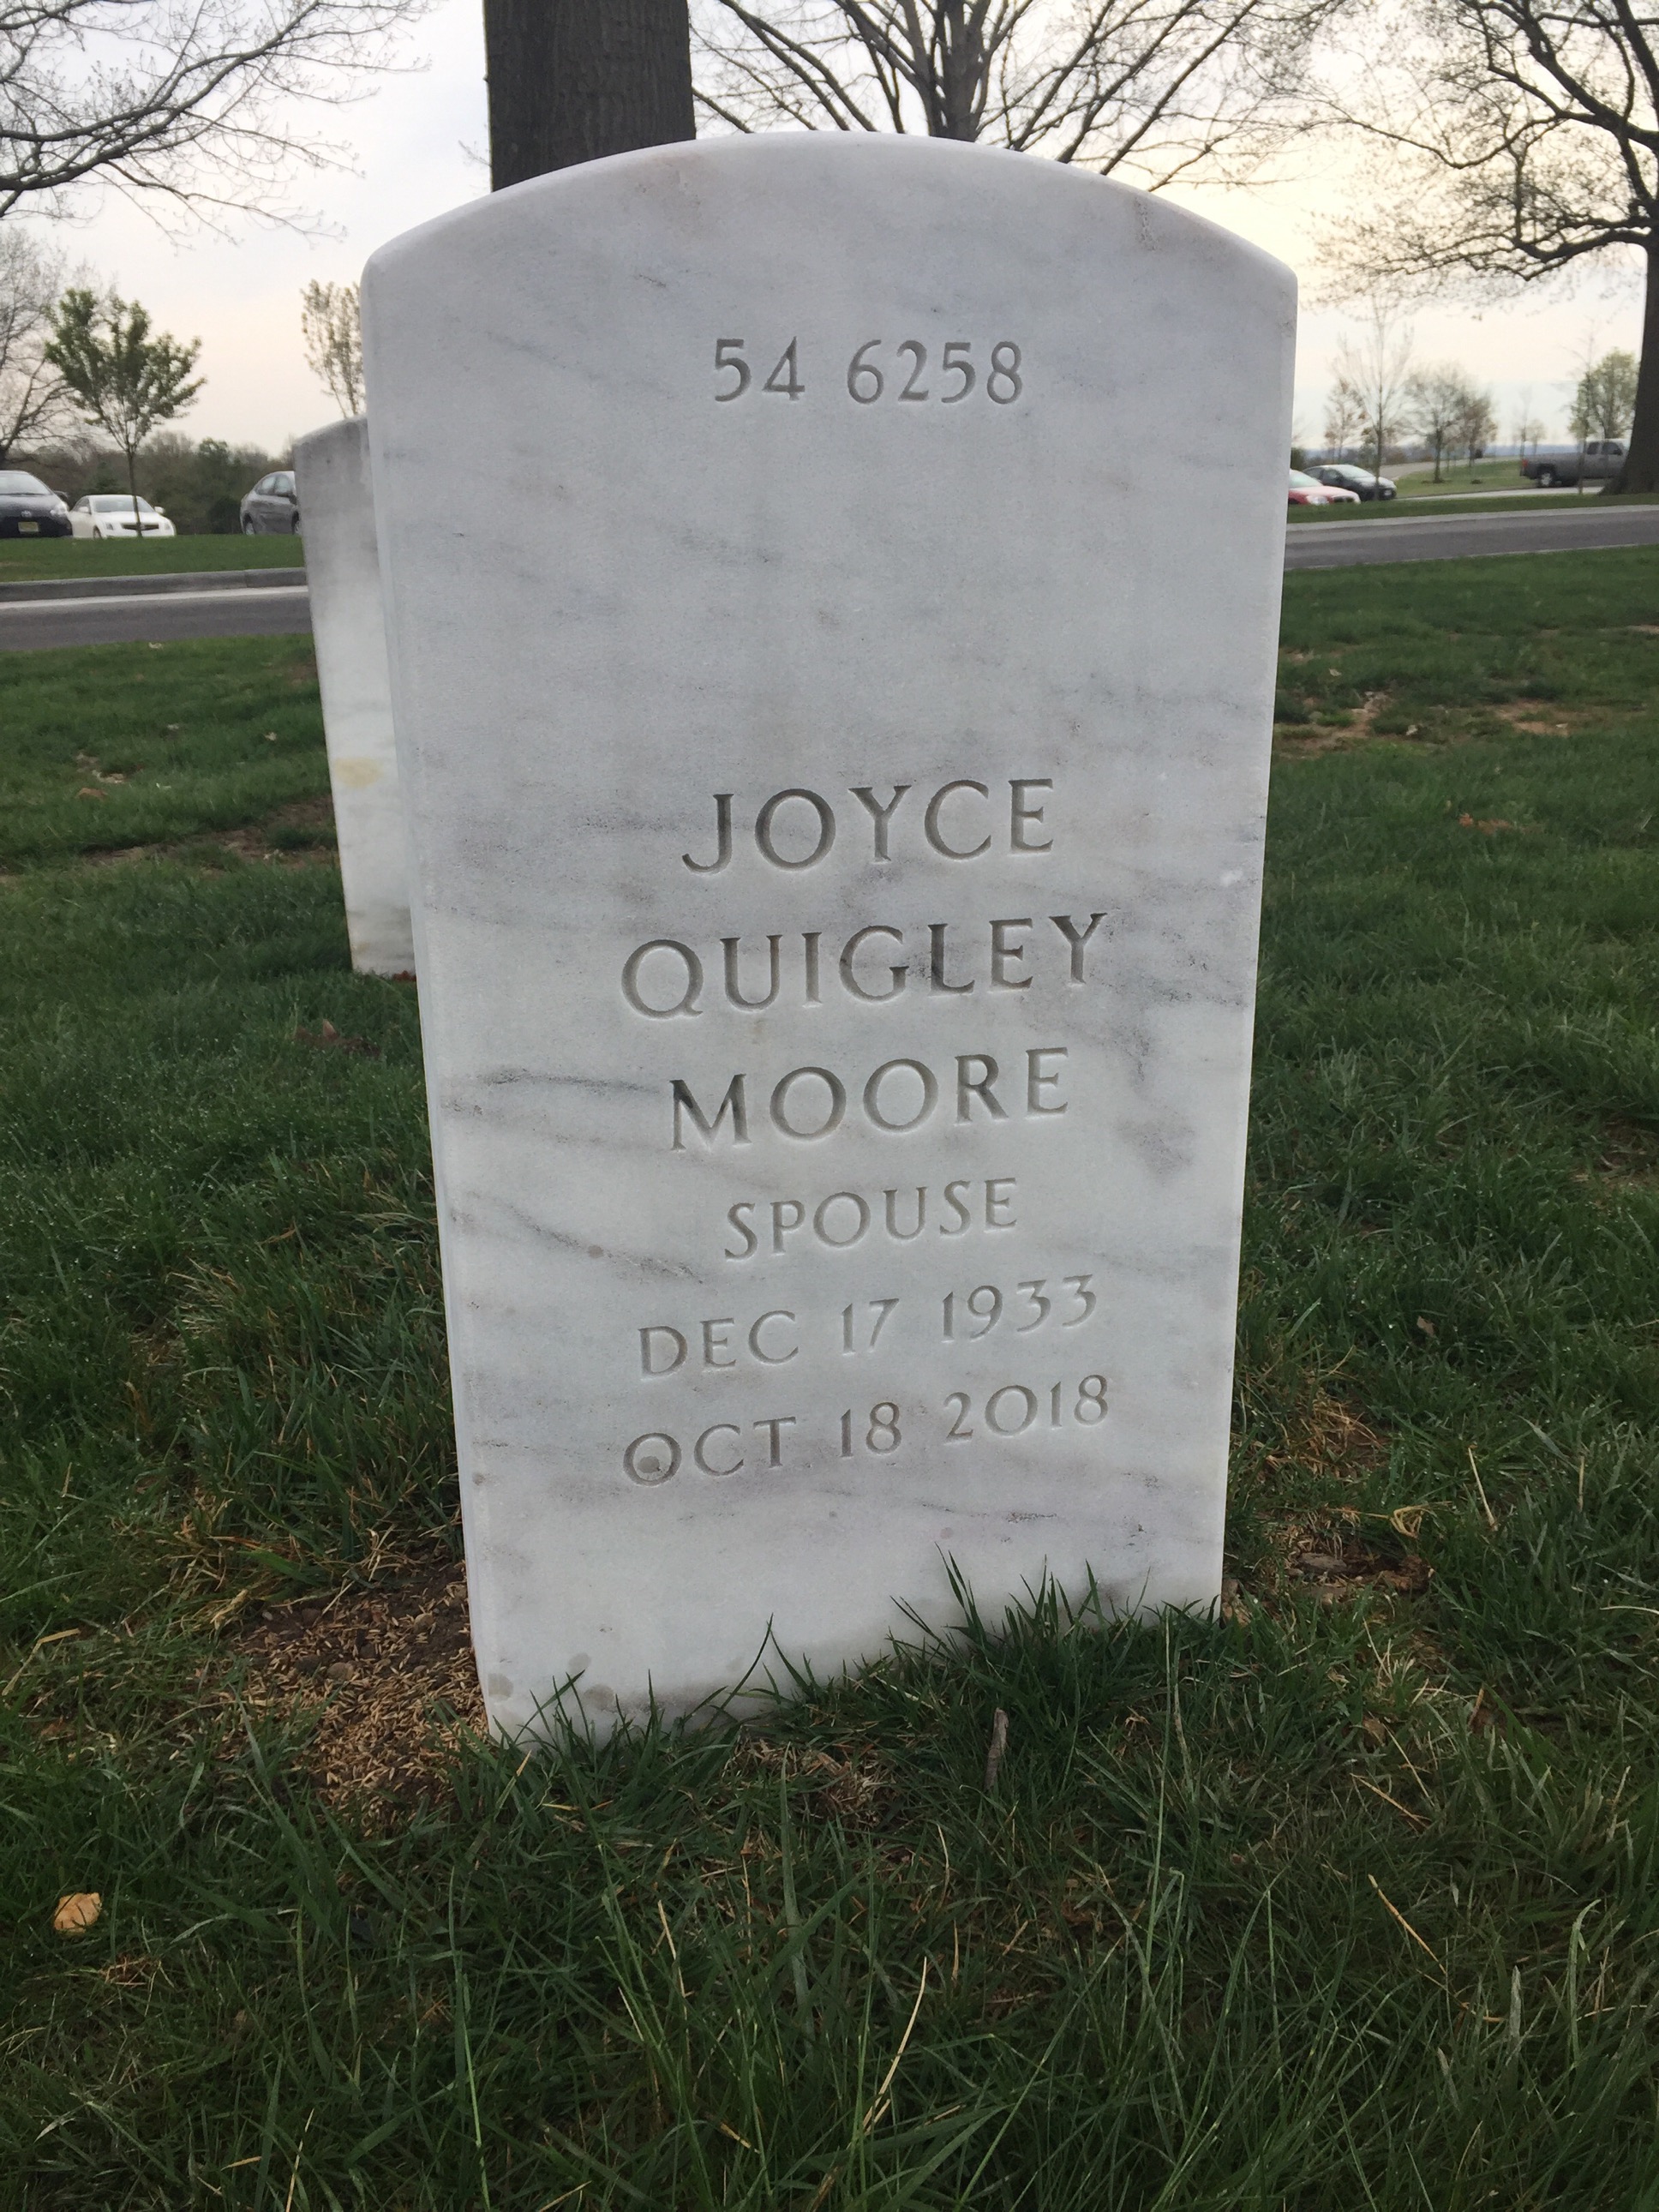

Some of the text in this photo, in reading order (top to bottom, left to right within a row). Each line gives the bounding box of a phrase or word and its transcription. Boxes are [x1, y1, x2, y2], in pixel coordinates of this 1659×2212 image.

[713, 336, 1024, 404] 54 6258
[681, 778, 1054, 874] JOYCE
[620, 913, 1108, 1020] QUIGLEY
[669, 1047, 1069, 1151] MOORE
[724, 1177, 1018, 1261] SPOUSE
[637, 1274, 1098, 1379] DEC 17 1933
[622, 1375, 1109, 1487] OCT 18 2018
